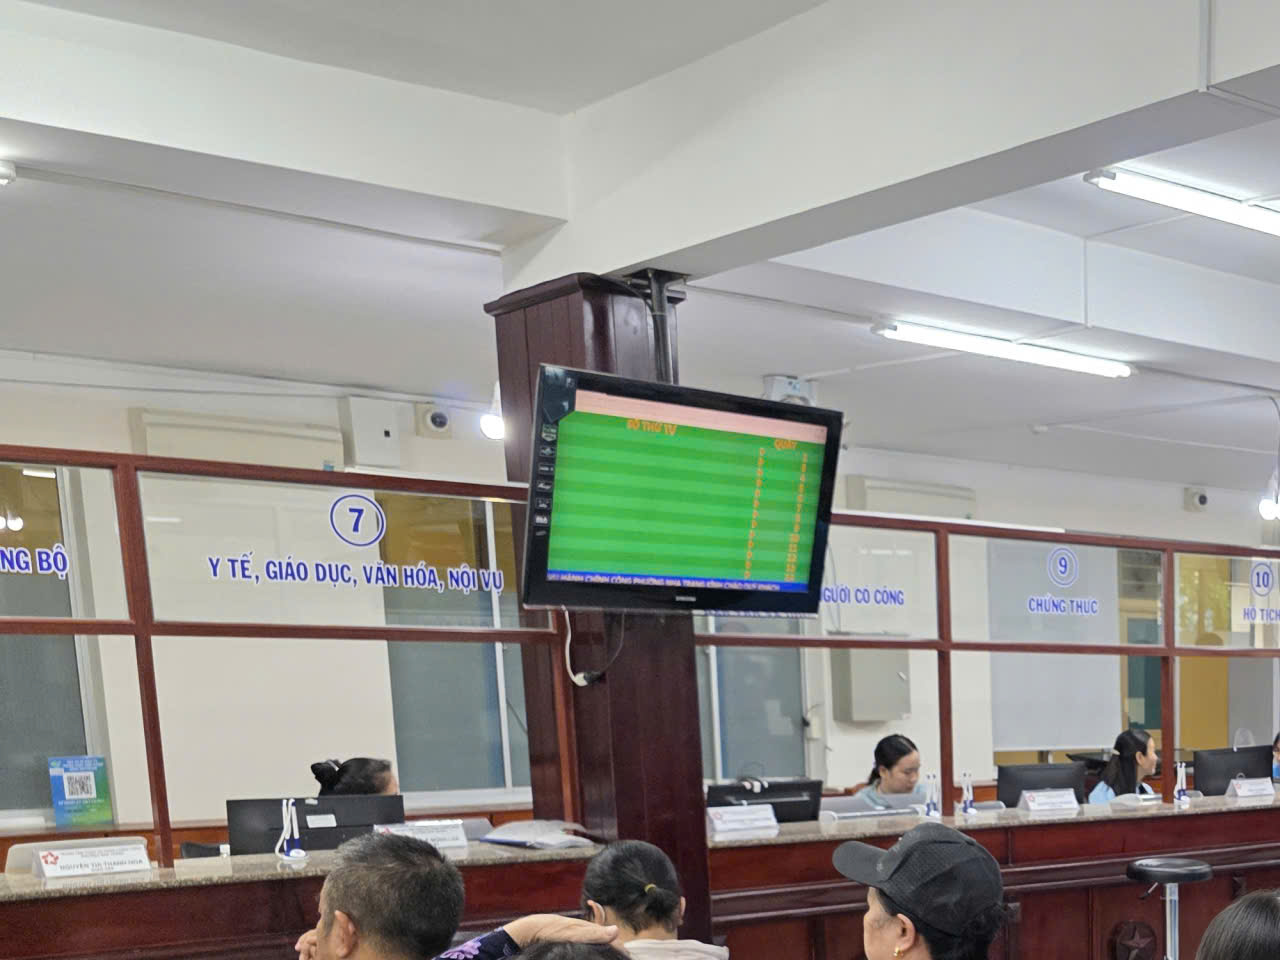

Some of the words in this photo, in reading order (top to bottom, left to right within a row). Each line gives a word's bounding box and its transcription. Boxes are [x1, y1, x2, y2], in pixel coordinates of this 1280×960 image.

[348, 507, 364, 533] 7
[37, 544, 68, 578] BỘ
[208, 557, 221, 578] Y
[227, 551, 260, 584] TẾ,
[265, 555, 309, 582] GIÁO
[315, 562, 358, 588] DỤC,
[362, 562, 398, 586] VĂN
[404, 560, 444, 593] HÓA,
[449, 563, 478, 593] NỘI
[481, 568, 504, 592] VỤ
[1058, 556, 1068, 575] 9
[1255, 571, 1270, 588] 10
